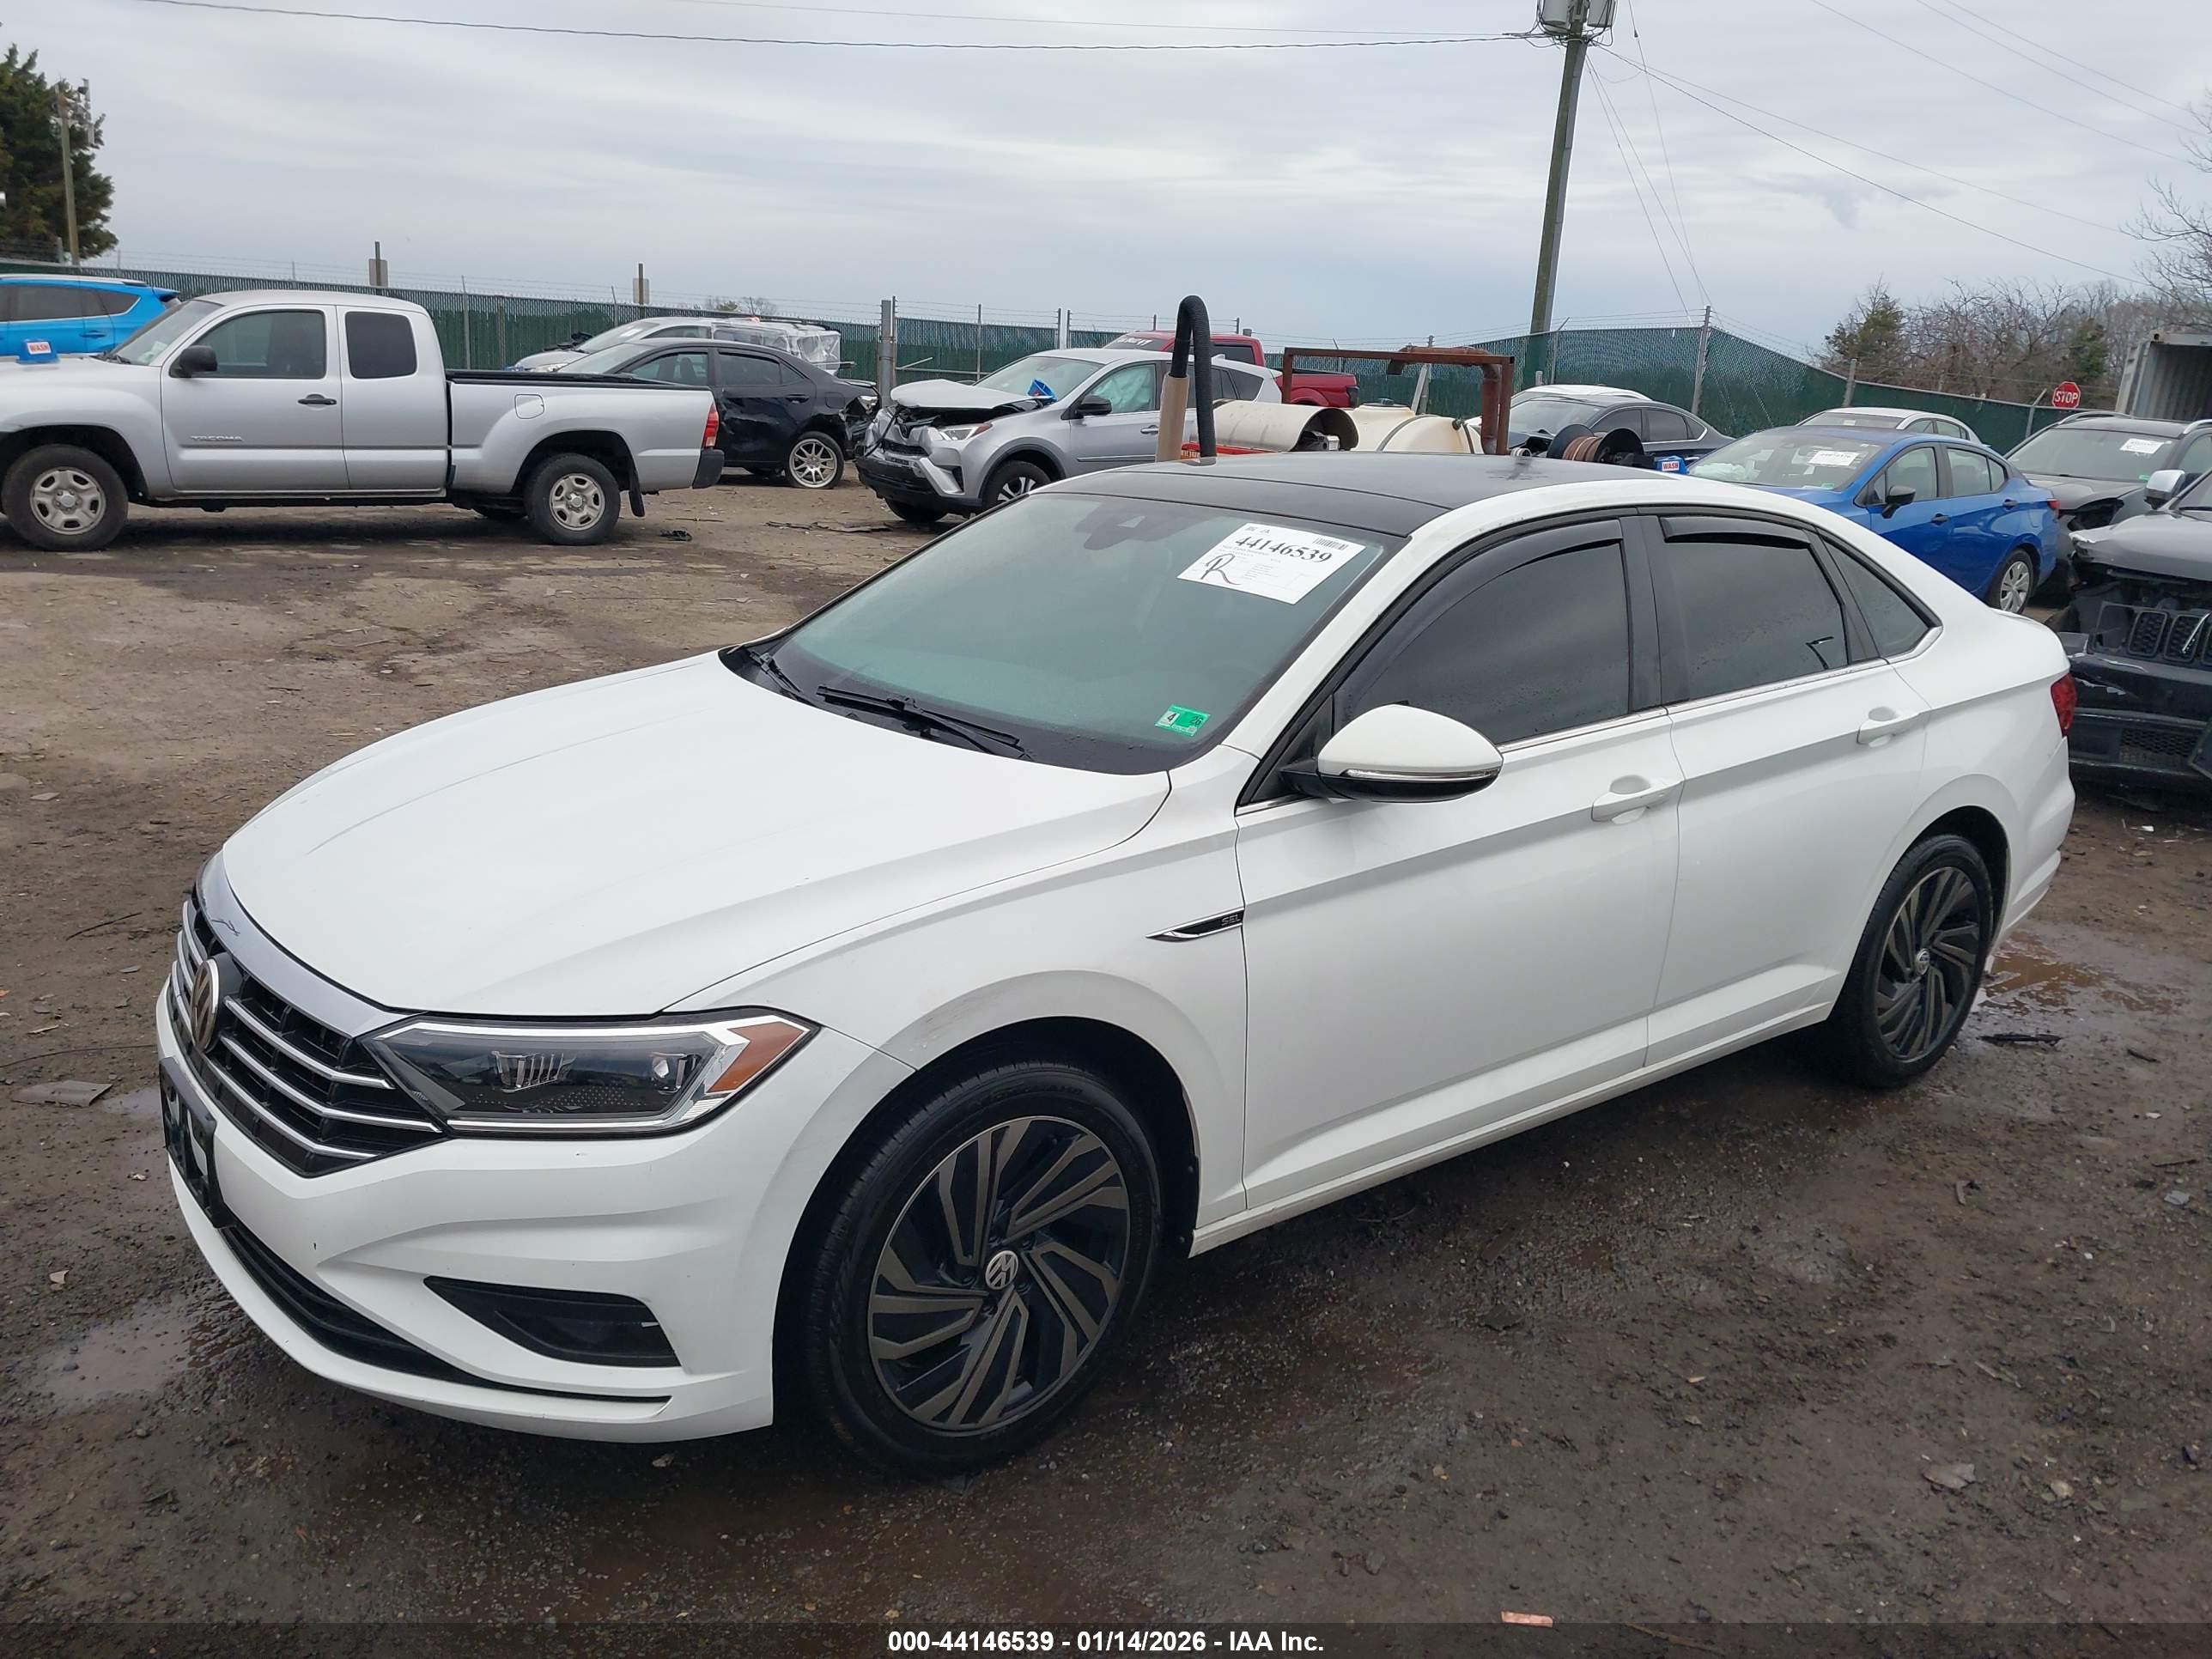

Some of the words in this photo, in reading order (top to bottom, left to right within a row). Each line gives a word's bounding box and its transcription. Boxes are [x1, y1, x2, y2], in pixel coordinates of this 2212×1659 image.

[2055, 391, 2078, 404] STOP
[1235, 536, 1333, 562] 44146539
[1200, 553, 1242, 586] R
[1168, 713, 1176, 722] 4
[1188, 715, 1204, 726] 26
[1221, 915, 1242, 927] SEL
